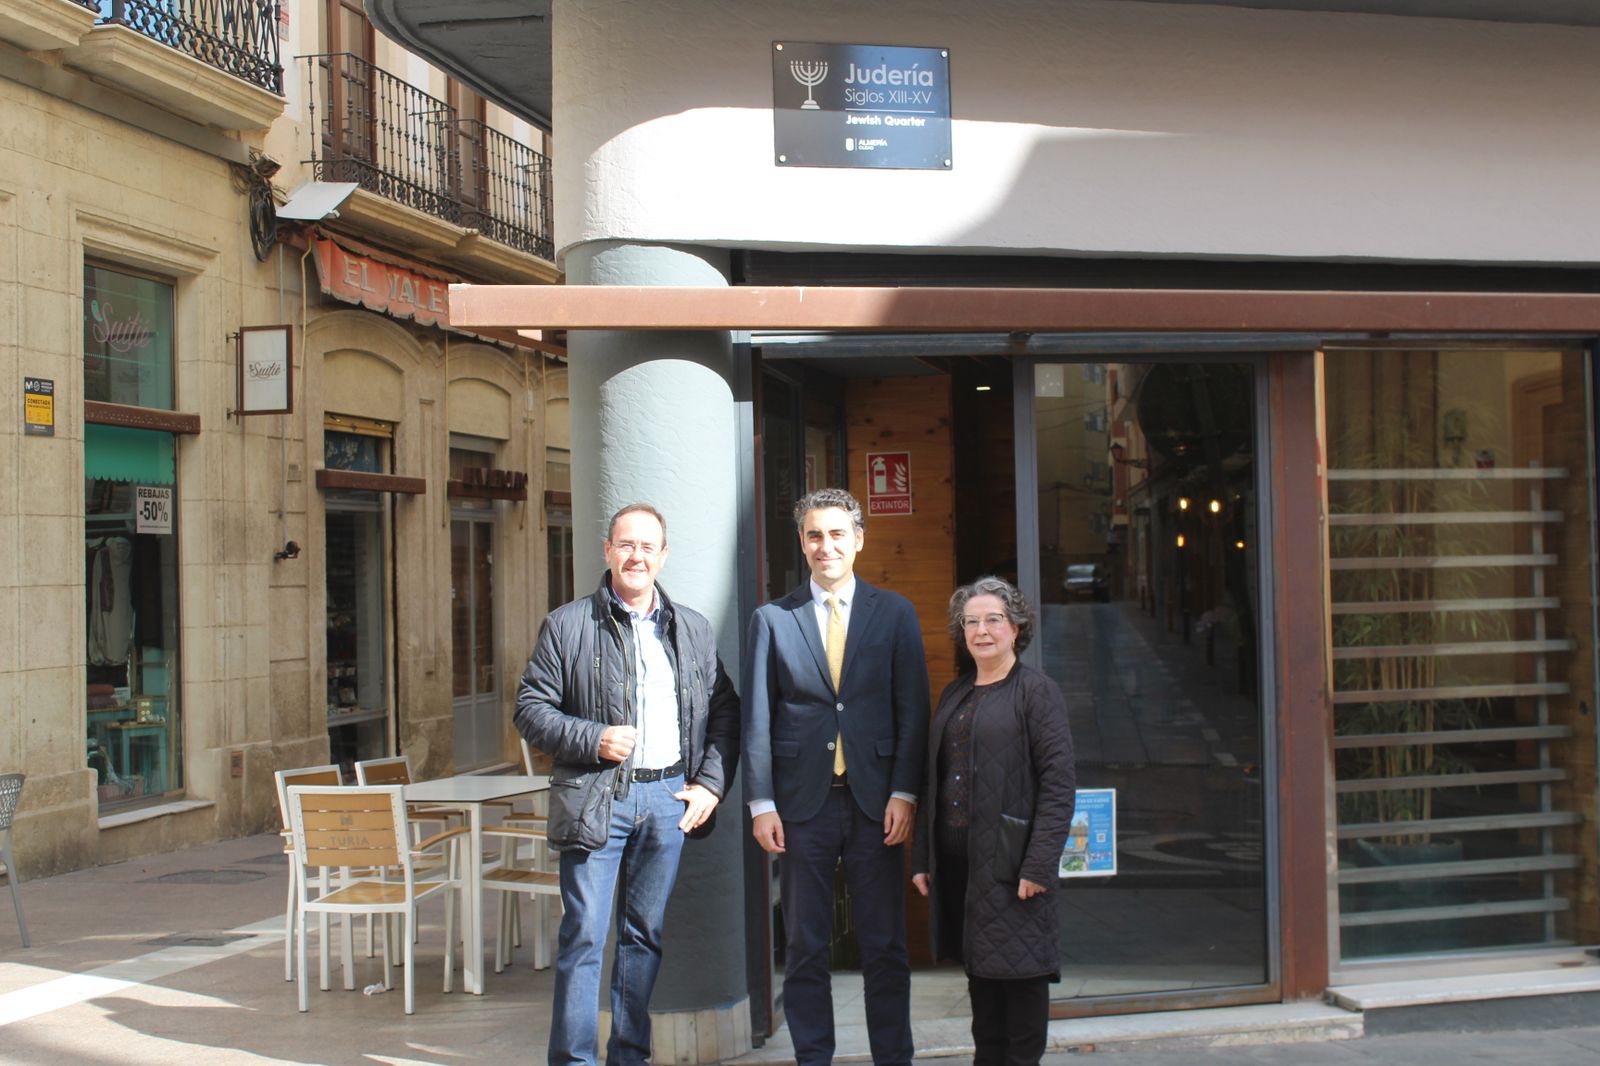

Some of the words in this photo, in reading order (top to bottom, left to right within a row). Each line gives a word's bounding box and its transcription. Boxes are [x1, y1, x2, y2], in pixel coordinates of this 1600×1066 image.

[844, 63, 934, 87] Judería
[845, 88, 885, 106] Siglos
[888, 90, 932, 105] XIII-XV
[846, 114, 882, 126] Jewish
[884, 115, 926, 127] Quarter
[343, 254, 377, 294] EL
[138, 488, 170, 500] REBAJAS
[139, 501, 169, 522] -50%
[871, 499, 910, 511] EXTINTOR
